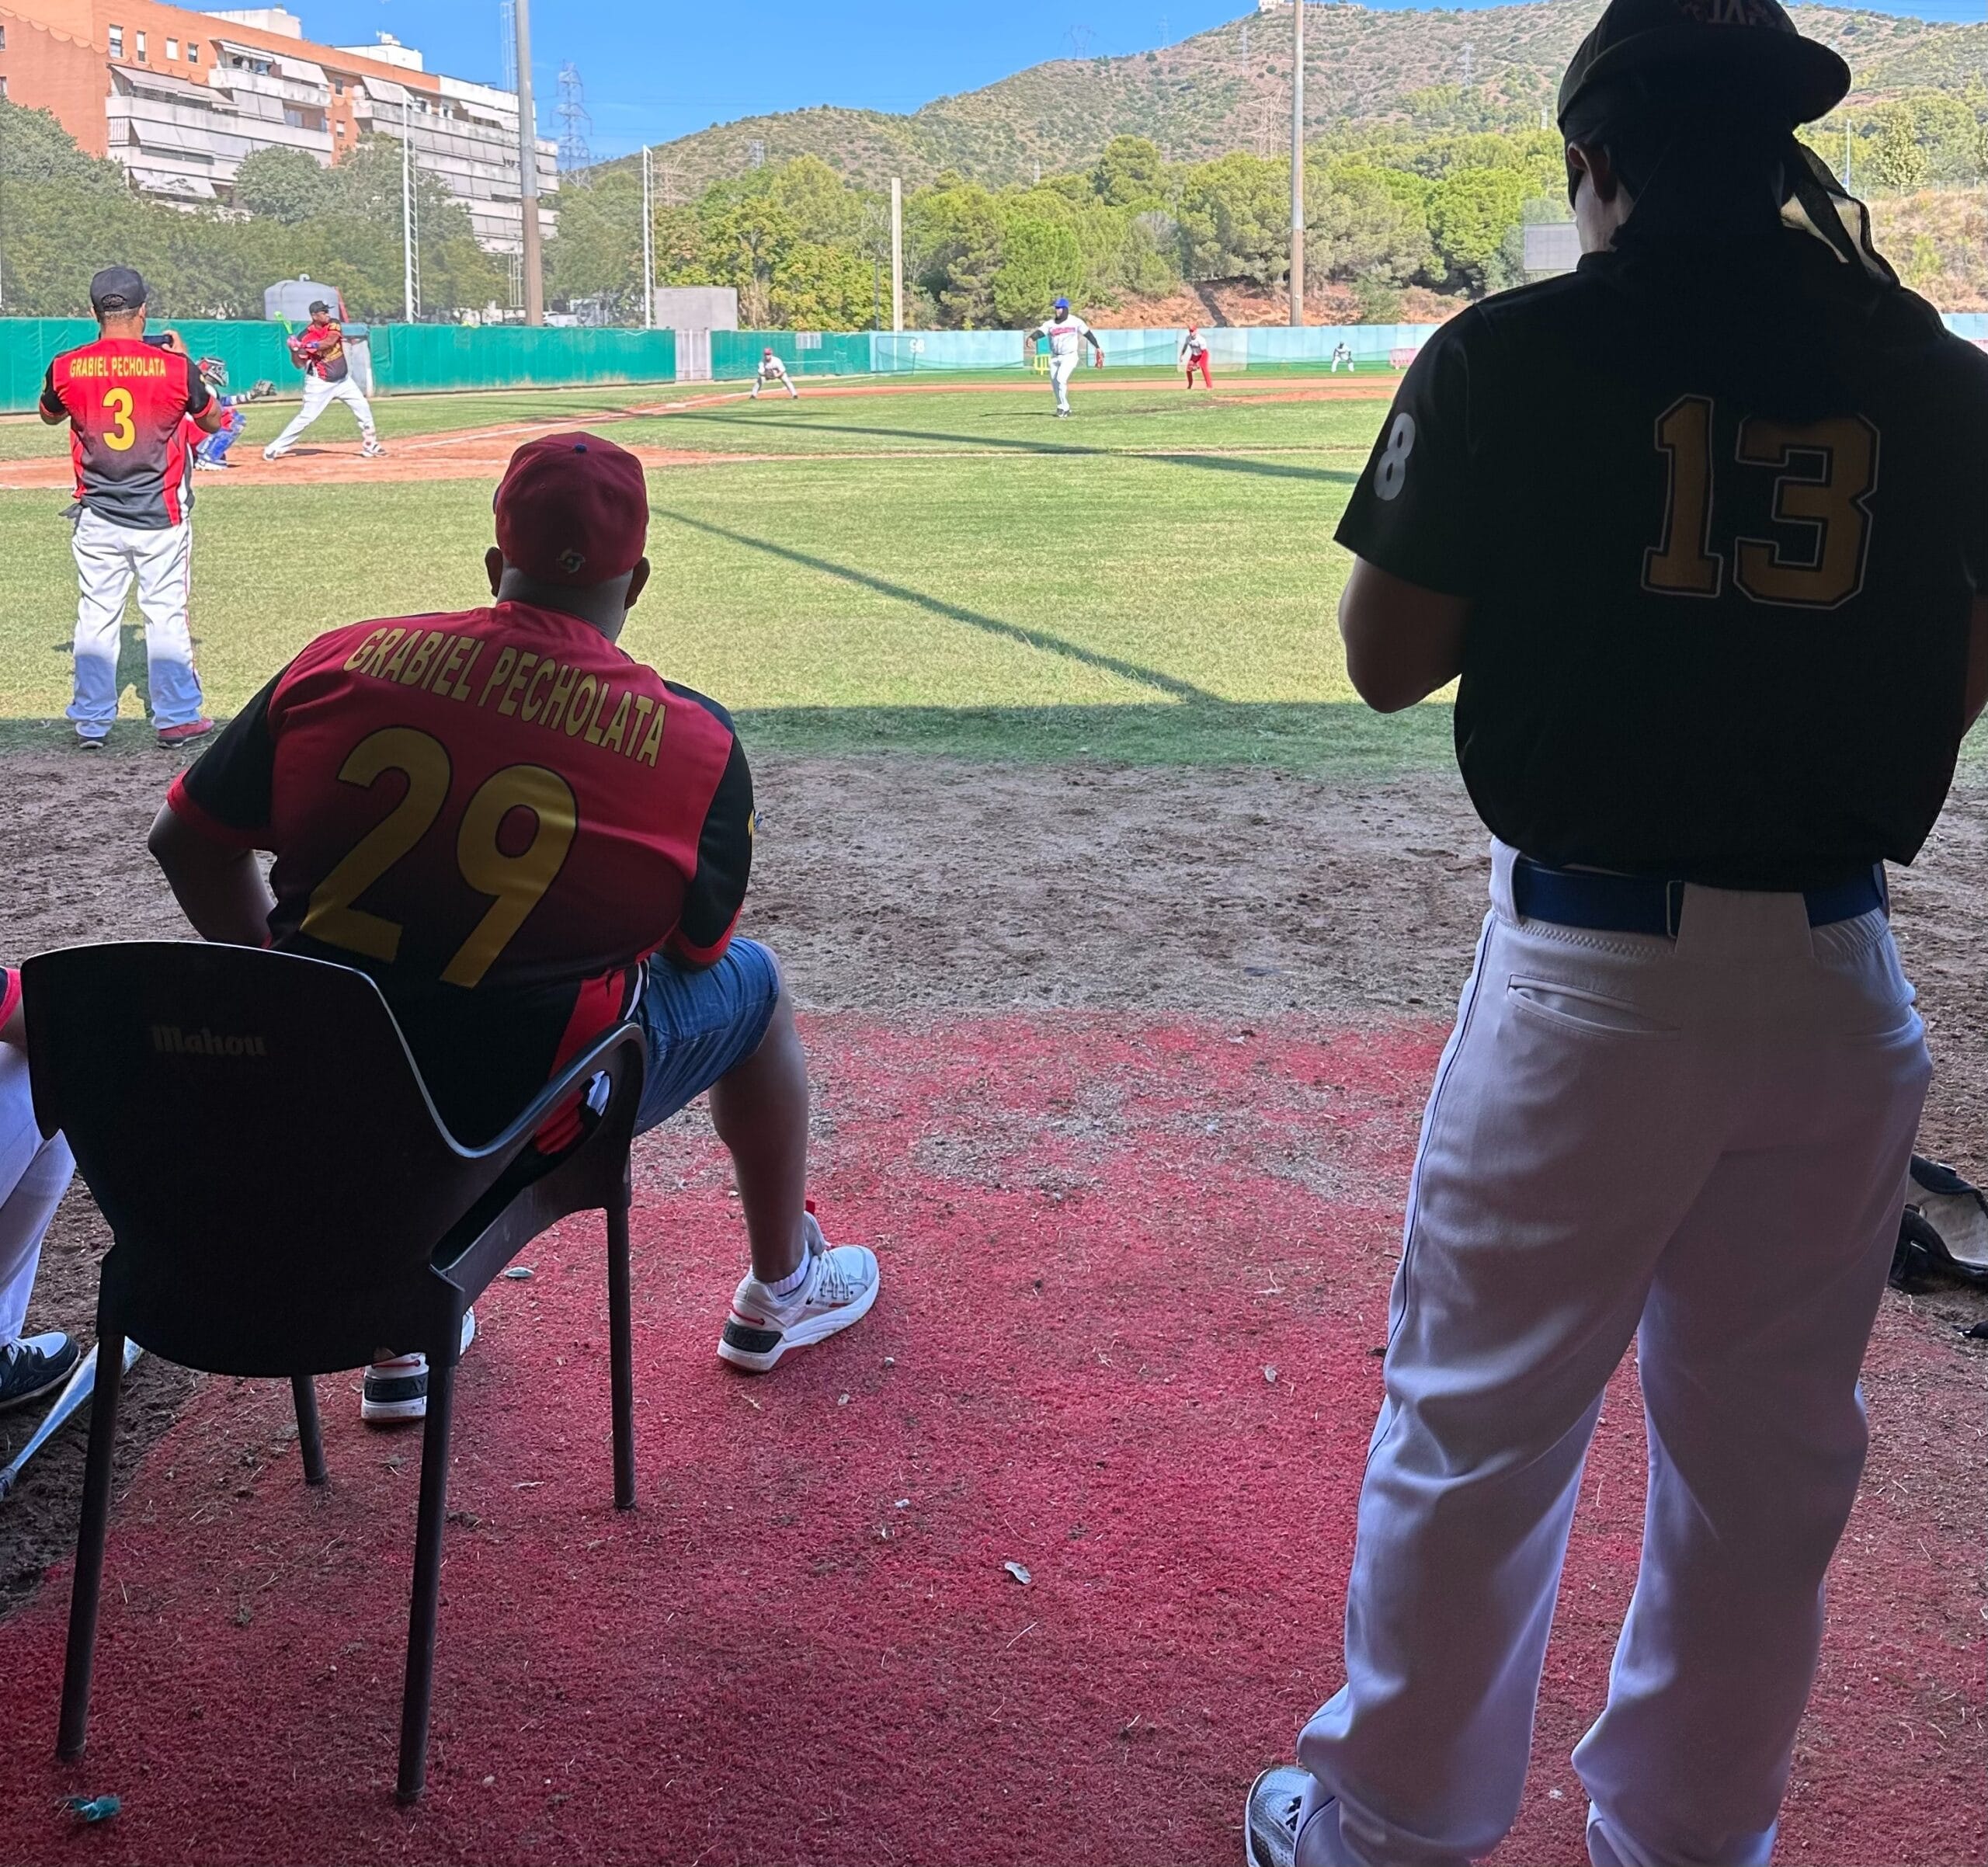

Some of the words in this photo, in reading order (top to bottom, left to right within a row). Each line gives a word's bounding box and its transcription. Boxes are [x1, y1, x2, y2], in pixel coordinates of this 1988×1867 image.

[70, 356, 109, 377] GRABIEL
[111, 356, 166, 377] PECHOLATA
[102, 387, 136, 451] 3
[1374, 412, 1415, 501] 8
[1640, 394, 1880, 610] 13
[342, 627, 485, 701] GRABIEL
[478, 645, 667, 768] PECHOLATA
[298, 725, 579, 989] 29
[151, 1024, 267, 1057] Mahou
